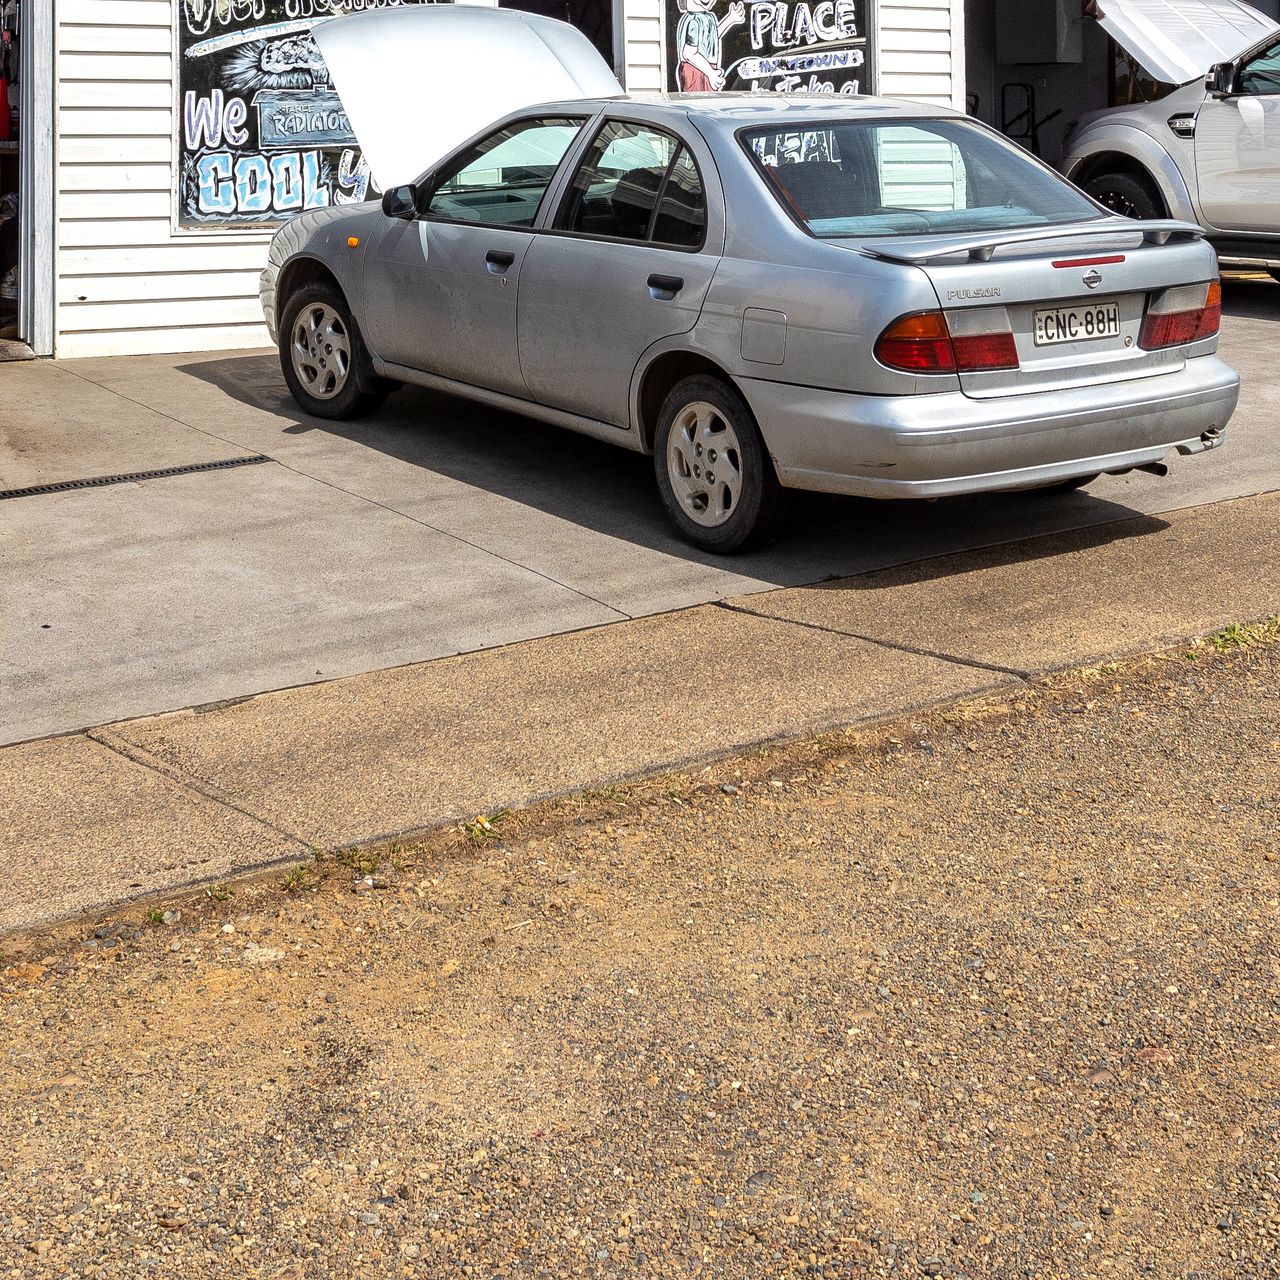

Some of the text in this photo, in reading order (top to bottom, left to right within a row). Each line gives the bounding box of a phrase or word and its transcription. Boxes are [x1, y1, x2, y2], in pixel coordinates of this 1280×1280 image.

[751, 0, 857, 49] PLACE
[184, 88, 249, 150] We
[272, 111, 351, 137] RADIATOR
[283, 105, 314, 113] TAREE
[197, 150, 329, 213] COOL
[947, 287, 1001, 301] PULSAR
